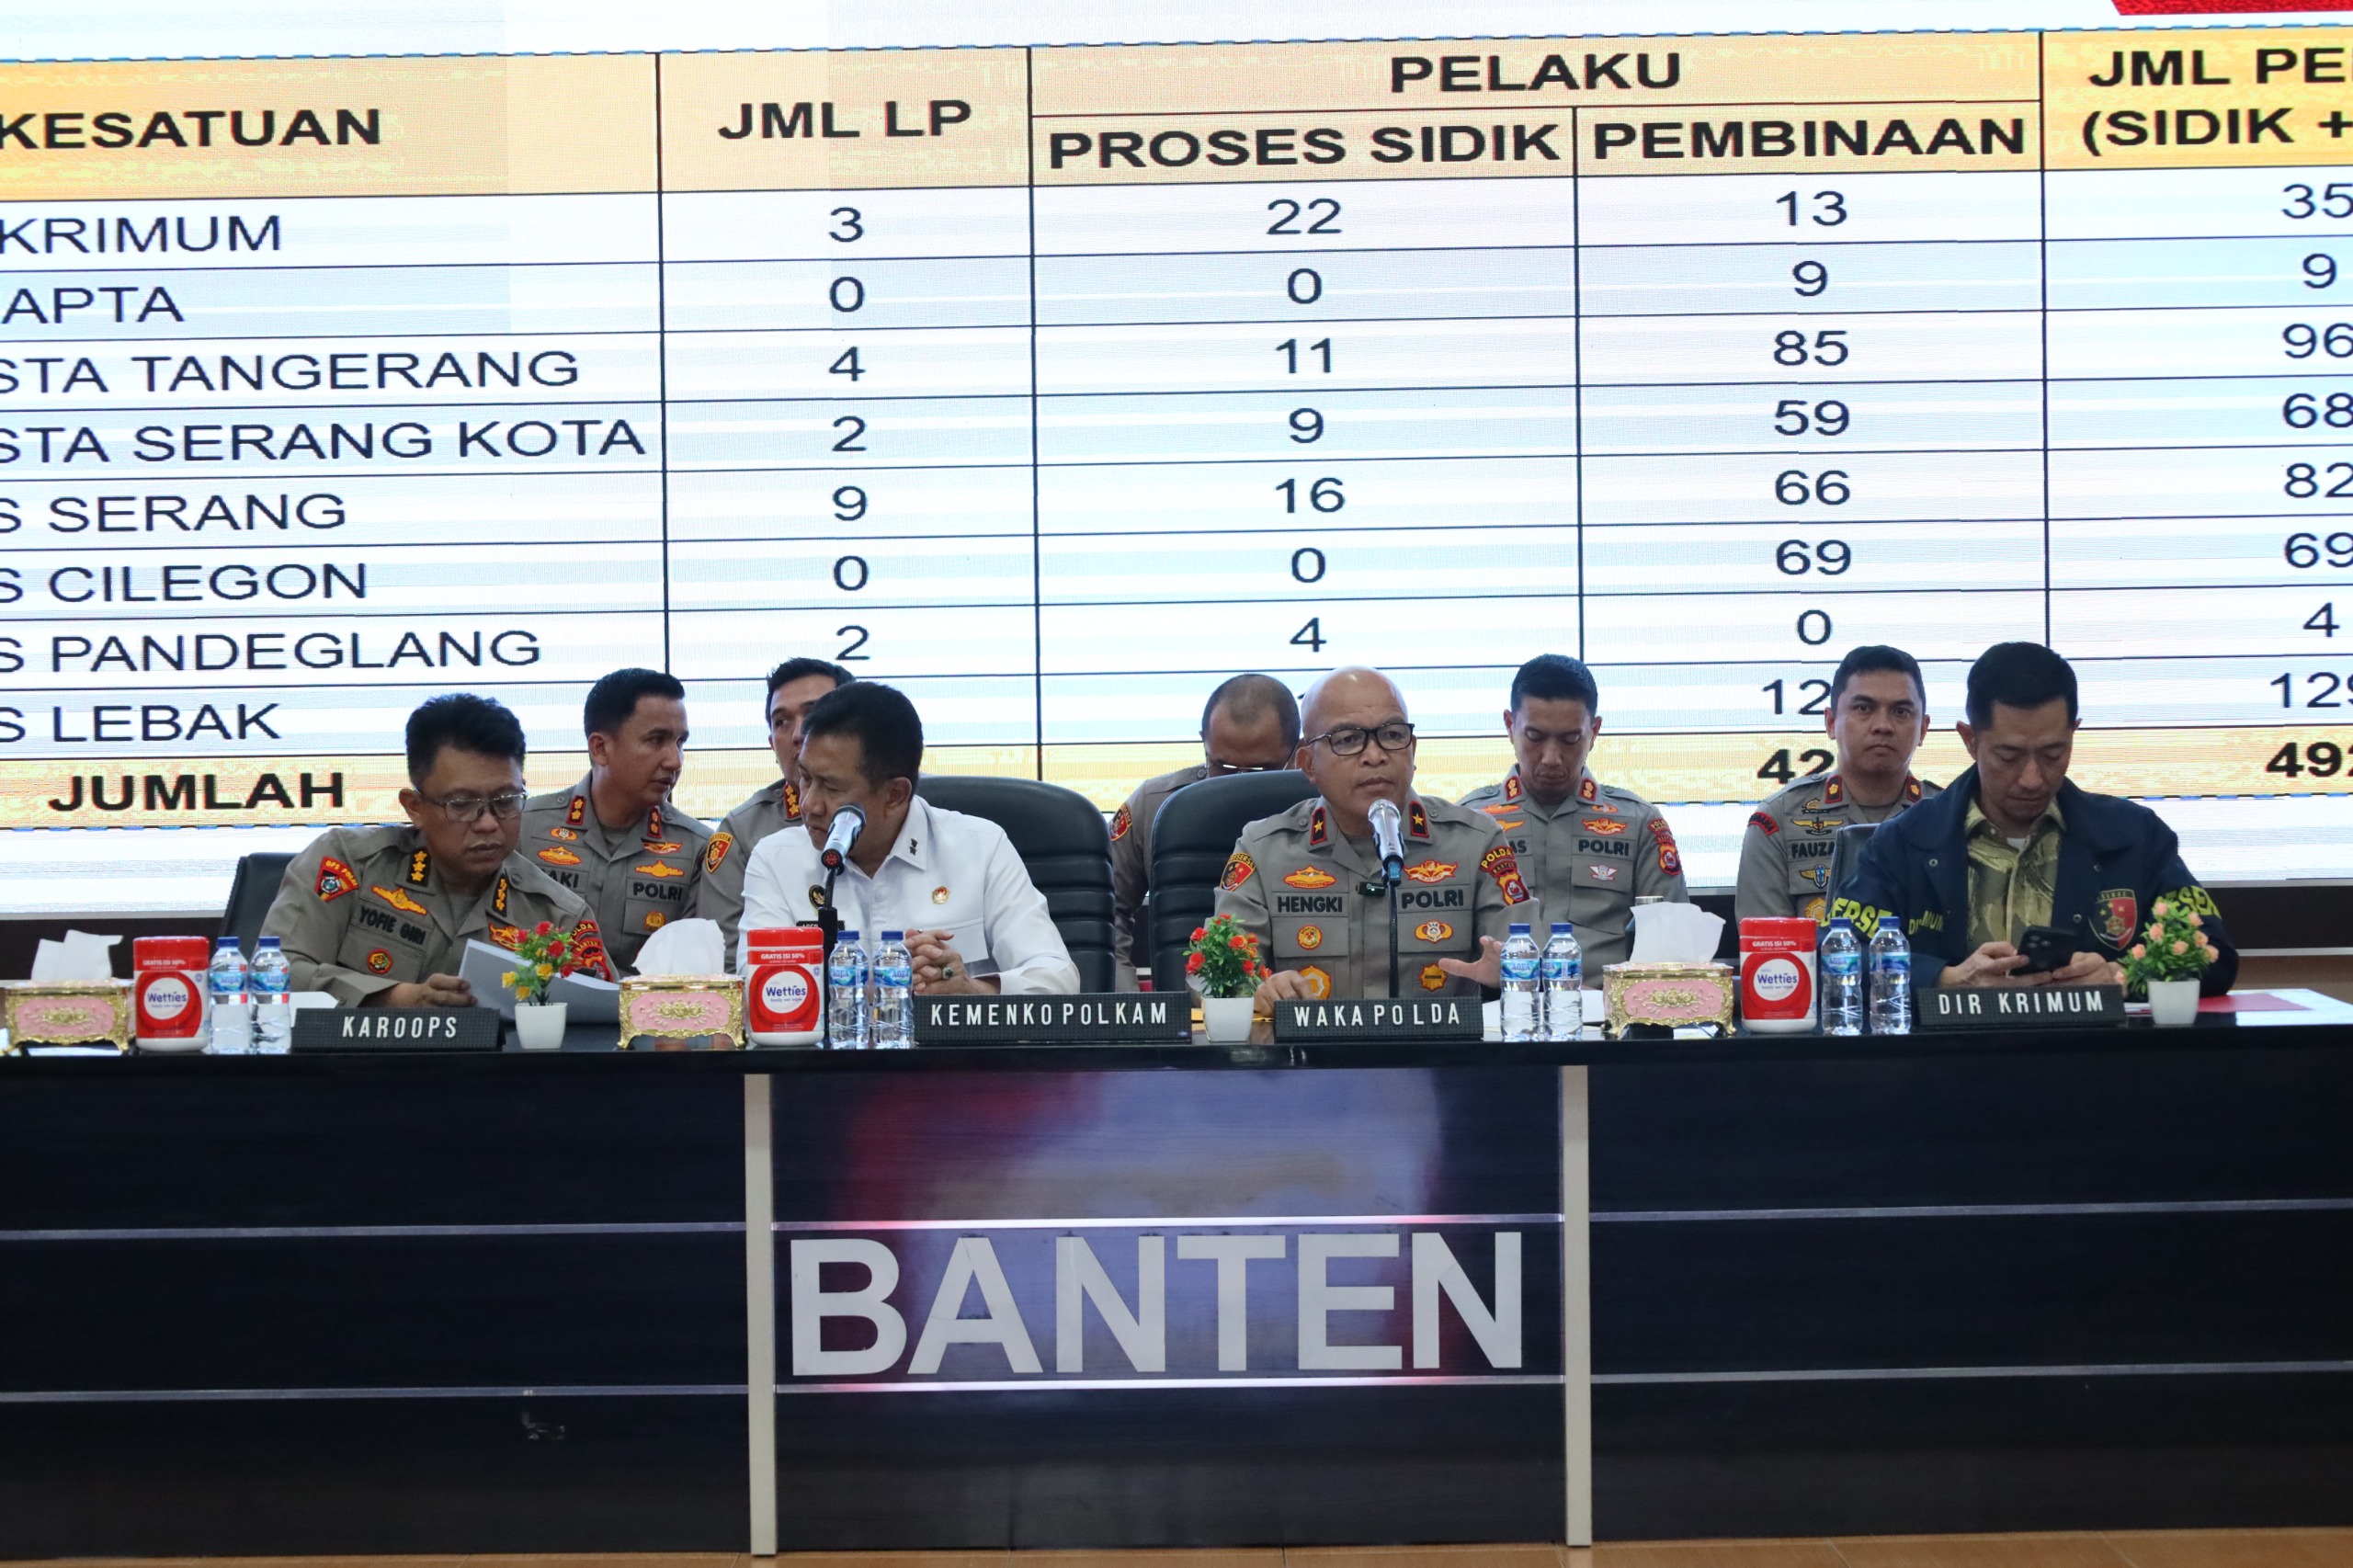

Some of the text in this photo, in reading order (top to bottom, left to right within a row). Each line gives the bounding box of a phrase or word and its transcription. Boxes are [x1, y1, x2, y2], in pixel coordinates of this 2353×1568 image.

[1392, 52, 1680, 93] PELAKU
[2090, 47, 2353, 87] JML PE
[0, 108, 381, 150] KESATUAN
[718, 99, 972, 140] JML LP
[2084, 108, 2353, 157] (SIDIK +
[1050, 124, 1560, 169] PROSES SIDIK
[1594, 118, 2023, 160] PEMBINAAN
[1267, 199, 1340, 234] 22
[1777, 190, 1847, 226] 13
[2284, 184, 2353, 219] 35
[0, 215, 278, 254] KRIMUM
[830, 207, 863, 243] 3
[1288, 268, 1322, 304] 0
[1792, 260, 1826, 297] 9
[2303, 254, 2336, 289] 9
[3, 287, 183, 324] APTA
[830, 277, 864, 312] 0
[1276, 338, 1331, 374] 11
[1774, 330, 1848, 366] 85
[2283, 324, 2353, 358] 96
[131, 351, 577, 392] TANGERANG
[829, 347, 864, 381] 4
[1290, 409, 1323, 444] 9
[1775, 400, 1849, 437] 59
[2283, 392, 2353, 428] 68
[134, 422, 431, 462] SERANG
[460, 419, 645, 458] KOTA
[832, 415, 865, 452] 2
[1276, 477, 1344, 513] 16
[1776, 470, 1850, 506] 66
[2285, 462, 2353, 498] 82
[50, 494, 345, 532] SERANG
[833, 486, 866, 521] 9
[1292, 548, 1324, 583] 0
[1777, 540, 1851, 575] 69
[2285, 532, 2353, 569] 69
[49, 563, 365, 603] CILEGON
[834, 556, 868, 591] 0
[1290, 618, 1324, 653] 4
[1797, 609, 1831, 645] 0
[2303, 603, 2338, 637] 4
[52, 631, 540, 672] PANDEGLANG
[836, 626, 869, 661] 2
[2272, 672, 2353, 709] 12
[53, 703, 278, 743] LEBAK
[2267, 742, 2353, 778] 49
[49, 772, 343, 812] JUMLAH
[1481, 847, 1513, 869] POLDA
[1578, 839, 1630, 857] POLRI
[540, 869, 579, 889] AKI
[633, 882, 683, 902] POLRI
[1278, 896, 1343, 913] HENGKI
[1401, 889, 1464, 909] POLRI
[766, 985, 806, 996] Wetties
[1757, 972, 1798, 984] Wetties
[148, 992, 187, 1003] Wetties
[931, 1002, 1166, 1026] KEMENKO POLKAM
[1293, 1002, 1460, 1028] WAKA POLDA
[1938, 990, 2103, 1015] DIR KRIMUM
[342, 1016, 457, 1039] KAROOPS
[790, 1232, 1522, 1376] BANTEN
